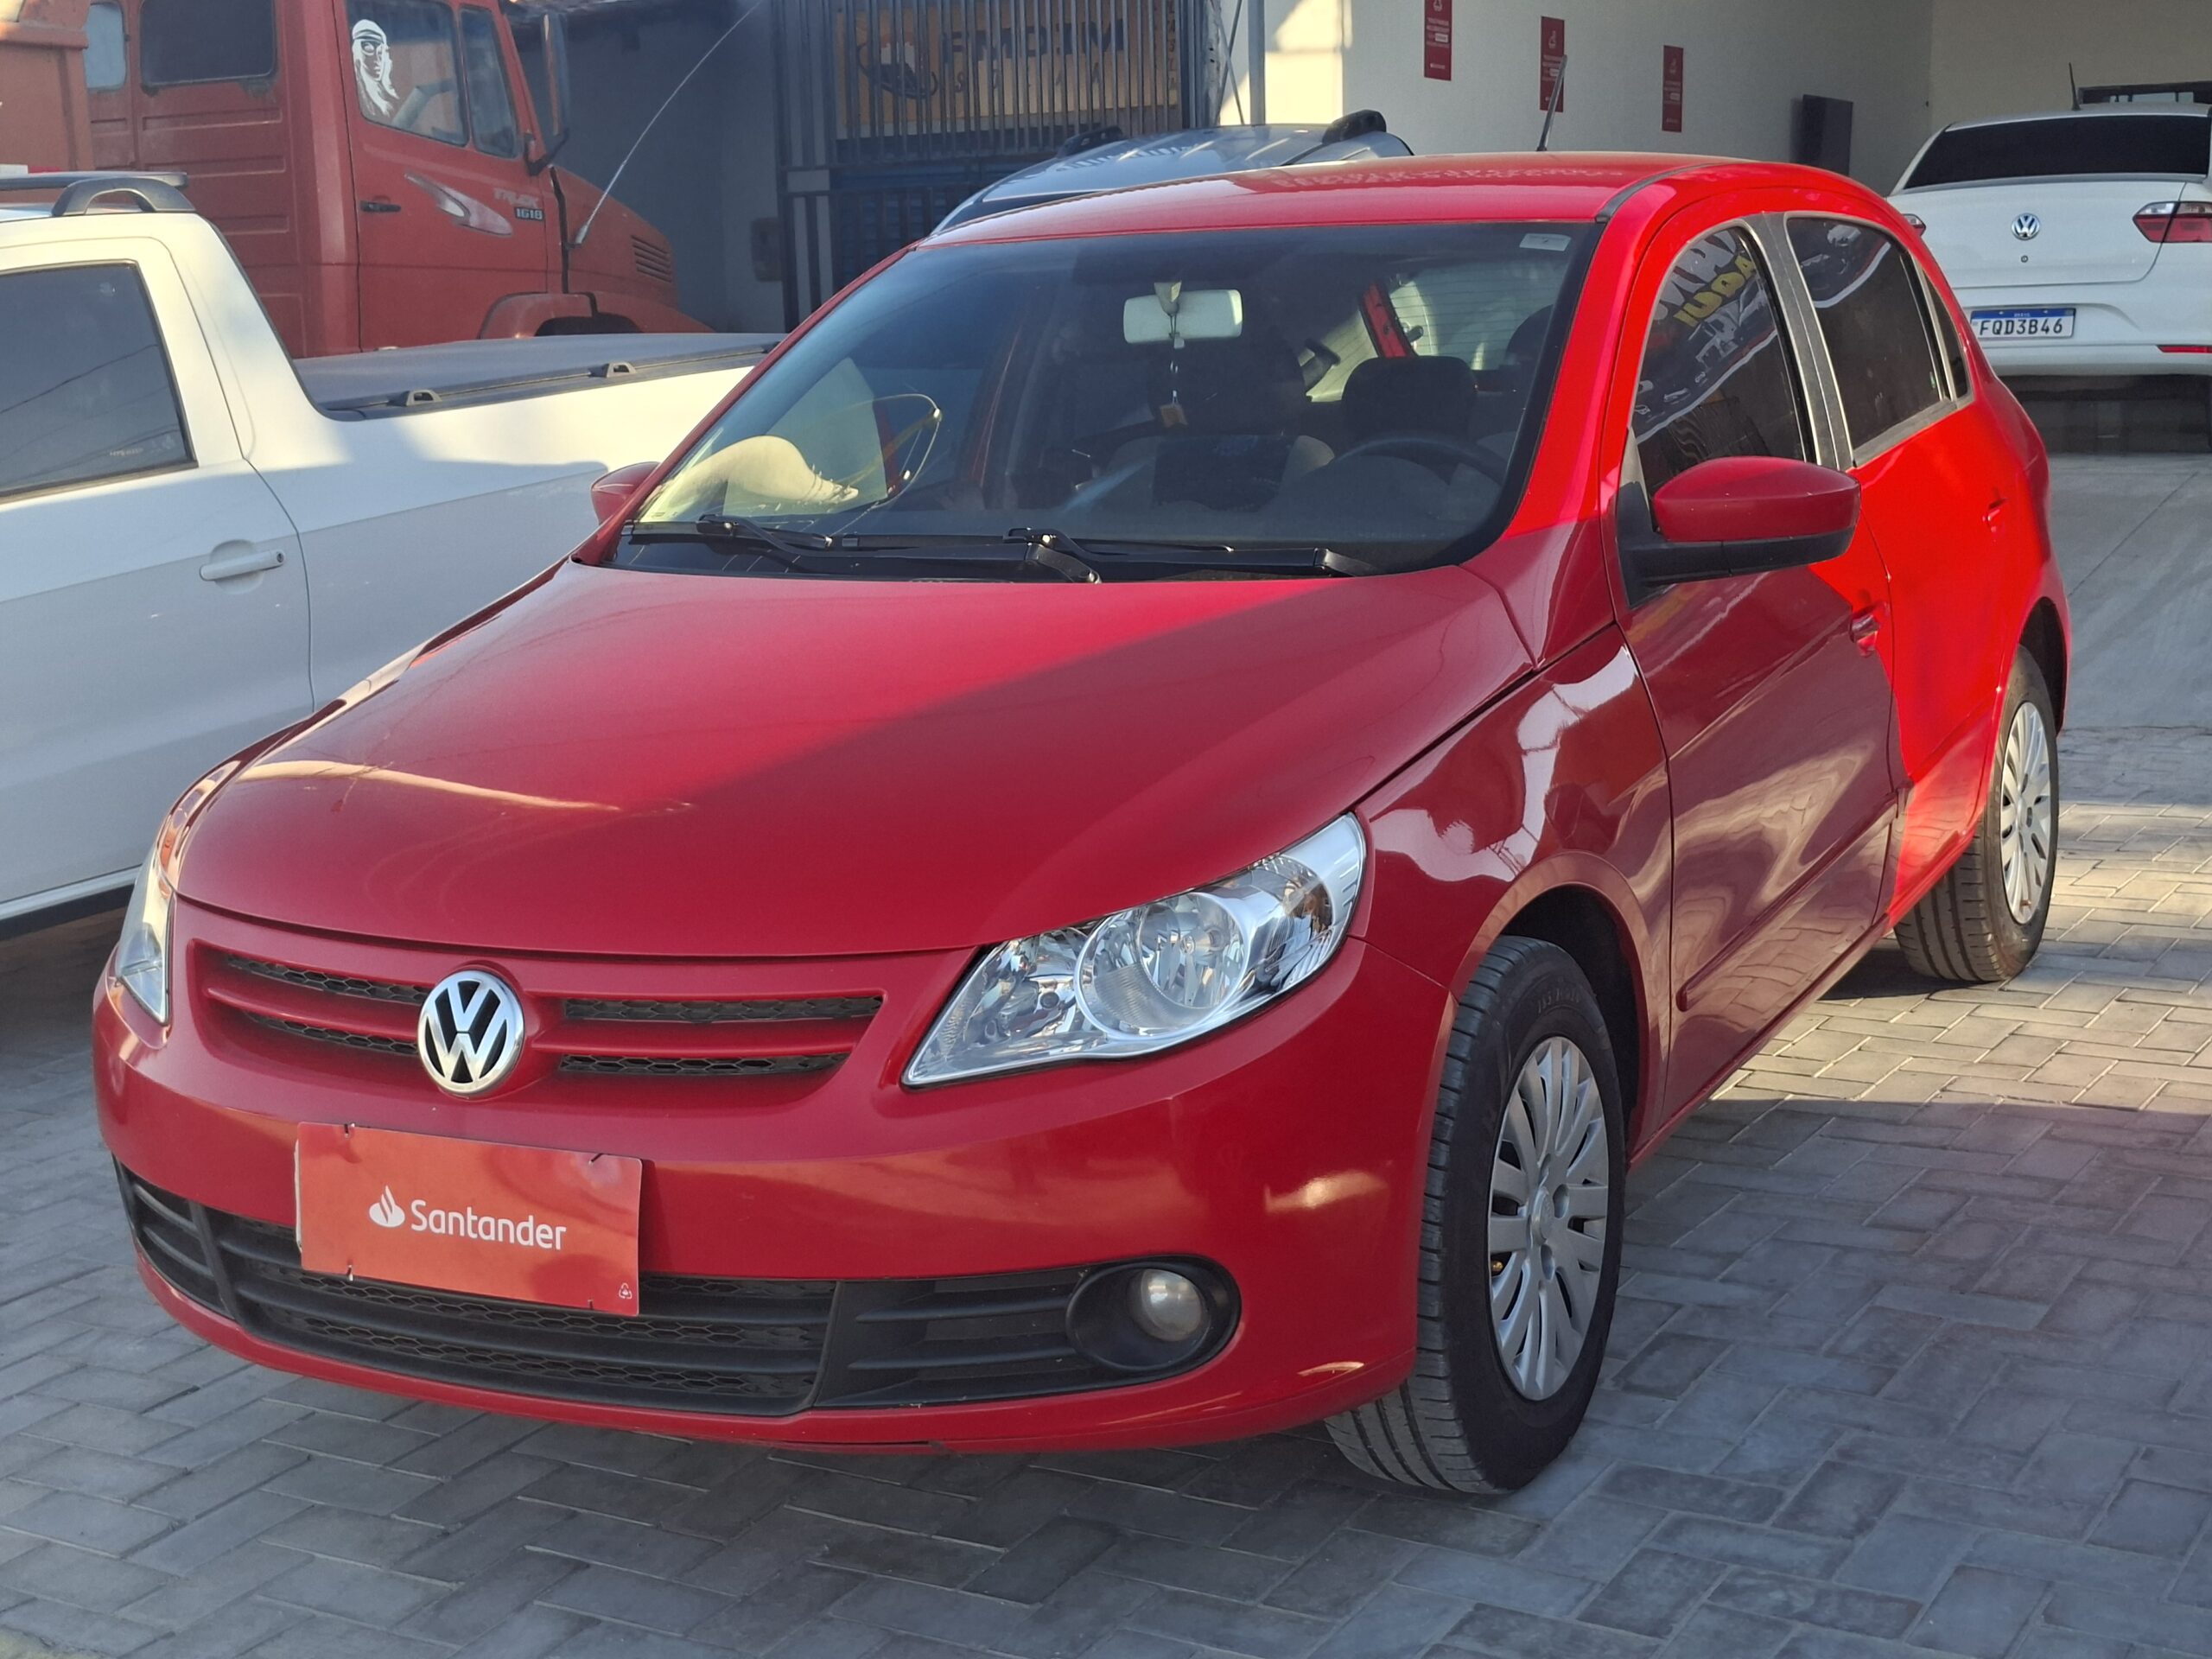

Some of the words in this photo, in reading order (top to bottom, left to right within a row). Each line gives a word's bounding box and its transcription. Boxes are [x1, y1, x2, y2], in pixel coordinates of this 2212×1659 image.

[516, 208, 543, 219] 1618
[1980, 318, 2063, 335] FQD3B46
[418, 969, 525, 1096] VW
[410, 1198, 568, 1251] Santander
